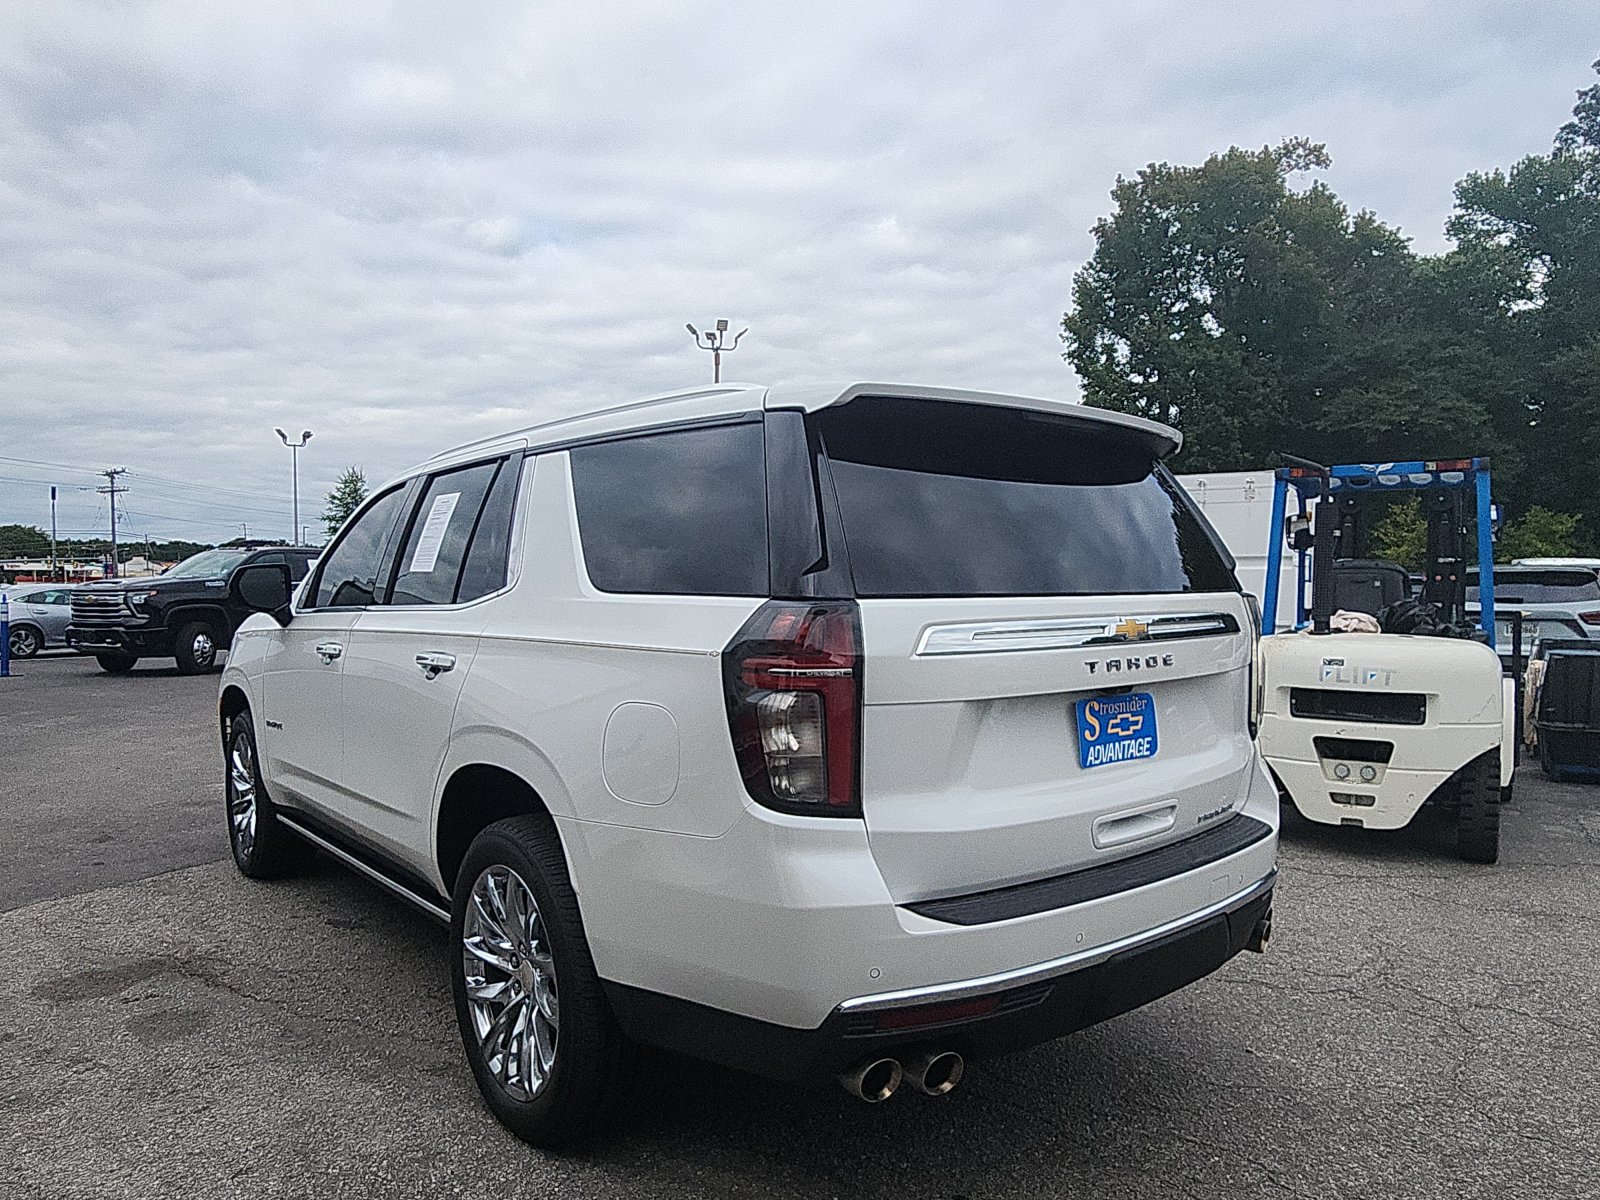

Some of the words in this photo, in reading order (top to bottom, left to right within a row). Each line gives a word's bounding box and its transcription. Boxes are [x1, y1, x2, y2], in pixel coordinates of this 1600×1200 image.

[1084, 655, 1175, 674] TAHOE
[1084, 697, 1147, 741] Strosnider
[1086, 737, 1152, 766] ADVANTAGE
